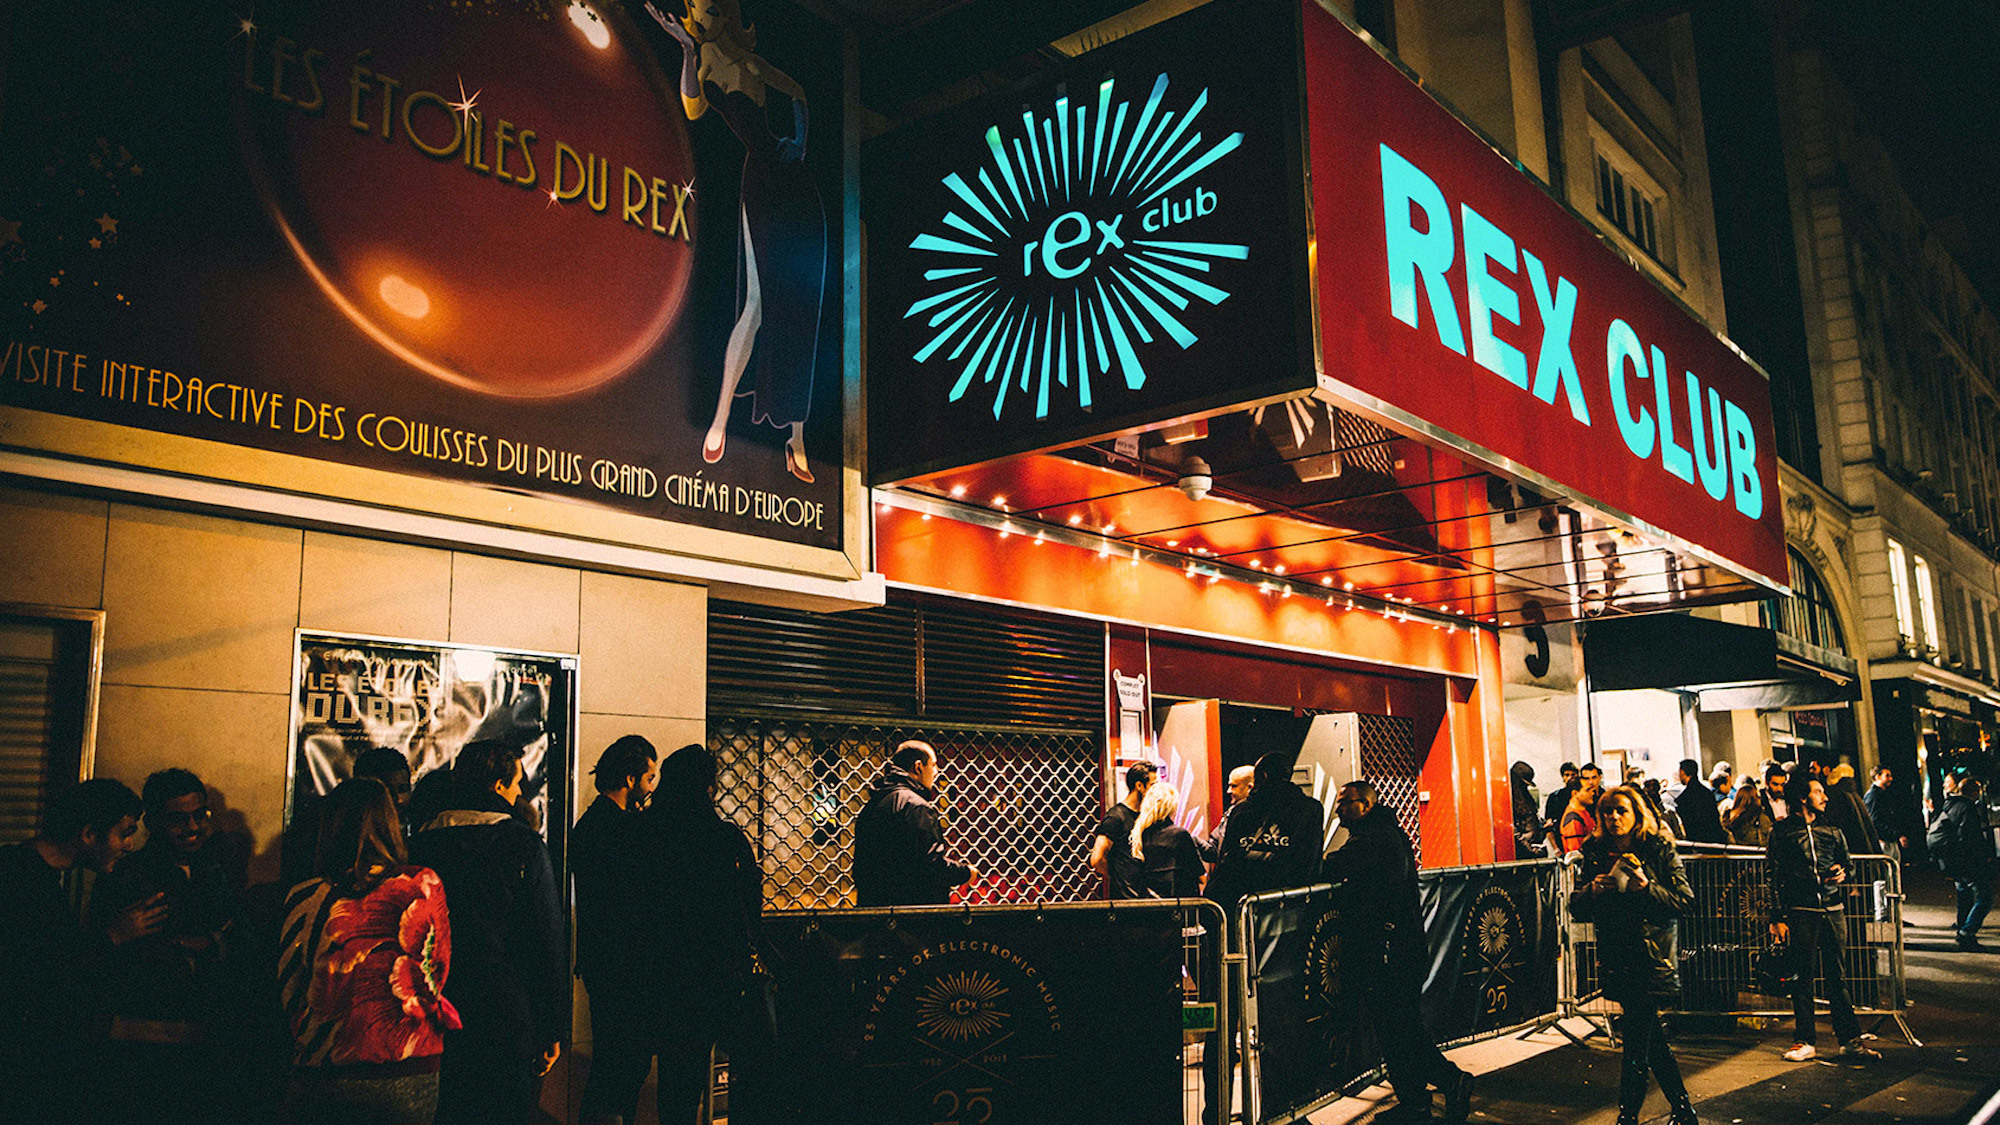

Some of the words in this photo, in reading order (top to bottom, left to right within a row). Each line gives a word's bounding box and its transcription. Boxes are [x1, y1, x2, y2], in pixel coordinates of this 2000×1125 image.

[243, 24, 325, 112] LES
[350, 50, 537, 186] ÉTOILES
[554, 140, 609, 212] DU
[623, 167, 692, 242] REX
[1024, 211, 1125, 280] rex
[1142, 186, 1218, 232] club
[1380, 142, 1591, 427] REX
[1607, 318, 1763, 520] CLUB
[101, 359, 283, 430] INTERACTIVE
[294, 398, 345, 441] DES
[356, 412, 488, 467] COULISSES
[496, 438, 529, 475] DU
[535, 446, 582, 486] PLUS
[590, 459, 658, 498] GRAND
[665, 470, 729, 514] CINÉMA
[735, 487, 824, 531] D'EUROPE
[870, 966, 908, 1014] YEARS
[912, 948, 932, 965] OF
[939, 940, 1037, 978] ELECTRONIC
[1036, 981, 1062, 1032] MUSIC
[1486, 984, 1508, 1014] 25
